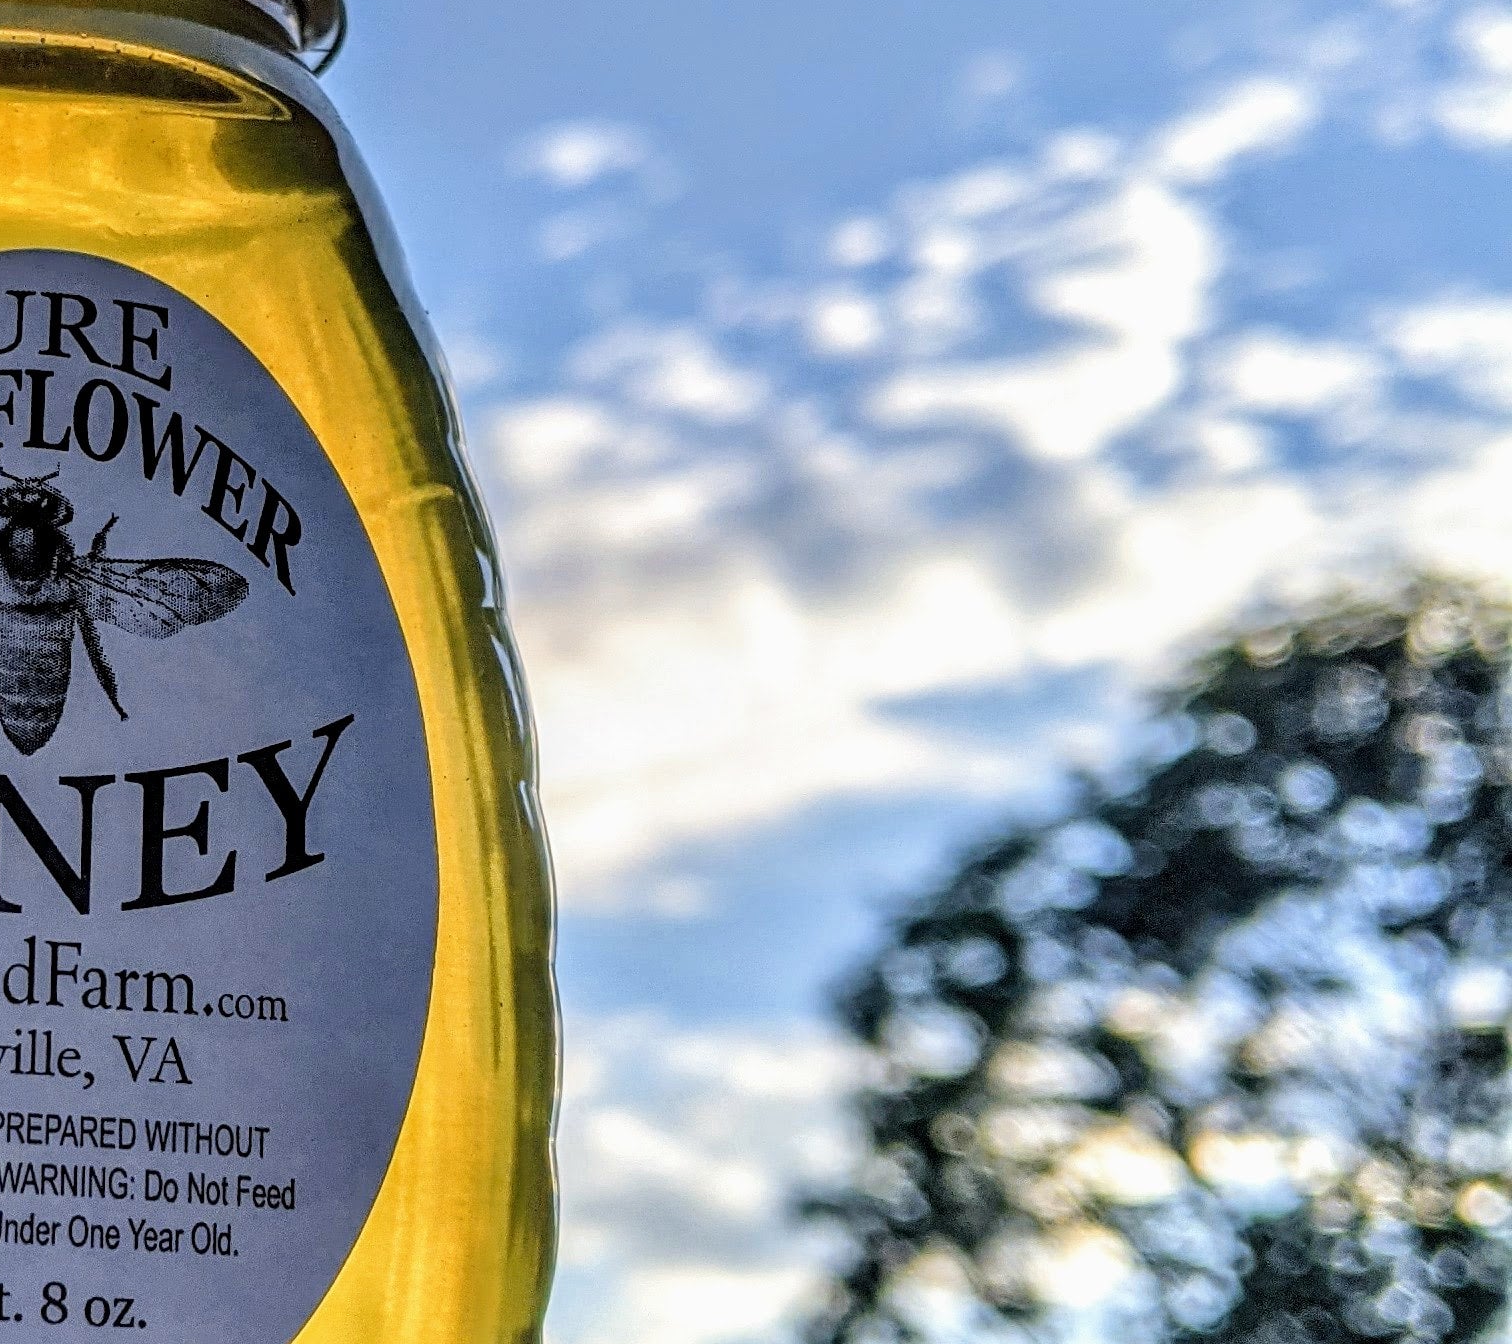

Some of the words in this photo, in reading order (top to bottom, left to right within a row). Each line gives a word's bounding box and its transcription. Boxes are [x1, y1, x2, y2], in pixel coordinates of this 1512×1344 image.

[113, 1035, 193, 1085] VA
[144, 1119, 270, 1157] WITHOUT
[144, 1168, 178, 1202] Do
[187, 1172, 229, 1206] Not
[236, 1175, 295, 1209] Feed
[68, 1214, 120, 1250] One
[127, 1217, 183, 1252] Year
[190, 1221, 240, 1256] Old.
[39, 1280, 68, 1324] 8
[84, 1290, 147, 1329] oz.
